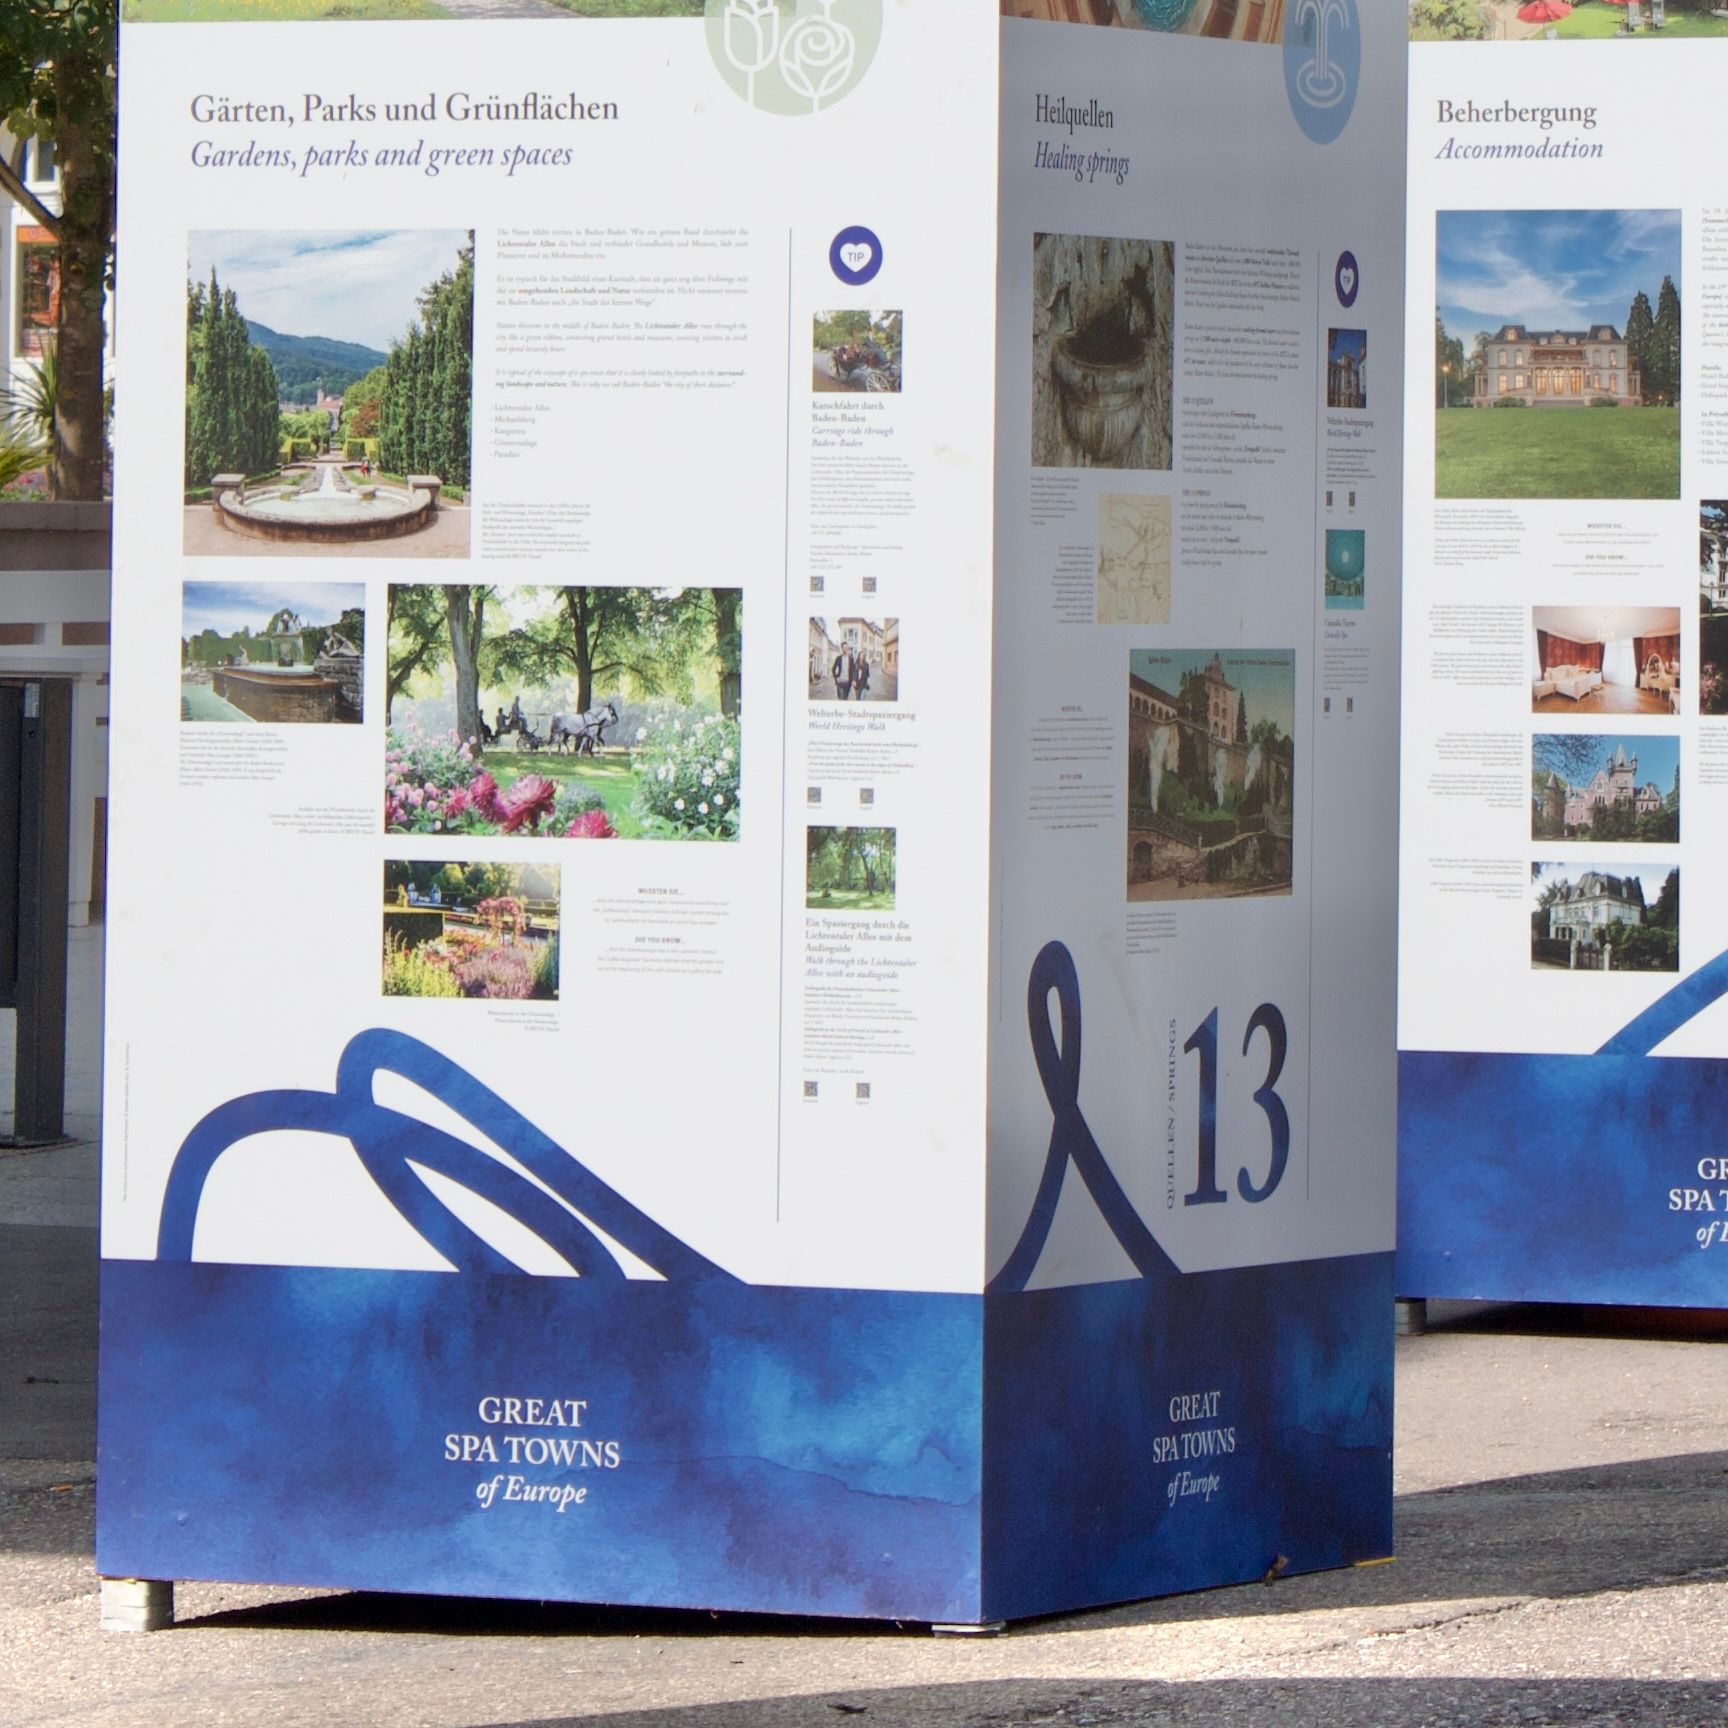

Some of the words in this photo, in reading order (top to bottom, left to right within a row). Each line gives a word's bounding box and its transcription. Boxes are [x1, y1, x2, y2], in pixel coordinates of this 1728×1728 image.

[190, 94, 295, 128] Gärten,
[303, 93, 377, 122] Parks
[385, 92, 437, 122] und
[445, 91, 619, 121] Grünflächen
[1035, 93, 1114, 136] Heilquellen
[1437, 99, 1598, 130] Beherbergung
[191, 140, 297, 171] Gardens,
[299, 139, 369, 178] parks
[374, 138, 425, 167] and
[424, 148, 494, 177] green
[500, 144, 573, 177] spaces
[1033, 140, 1086, 183] Healing
[1085, 148, 1130, 186] springs
[1434, 136, 1604, 160] Accommodation
[847, 252, 865, 262] TIP
[811, 412, 867, 423] Baden-Baden
[805, 918, 820, 928] Ein
[822, 918, 871, 930] Spaziergang
[872, 919, 895, 929] durch
[897, 920, 910, 929] die
[1168, 1019, 1176, 1102] SPRINGS
[1168, 1105, 1176, 1113] /
[1183, 1002, 1290, 1207] 13
[1167, 1117, 1176, 1210] QUELLEN
[1669, 1189, 1715, 1211] SPA
[1696, 1221, 1719, 1249] of
[478, 1396, 587, 1428] GREAT
[1169, 1391, 1221, 1423] GREAT
[445, 1434, 499, 1462] SPA
[504, 1436, 620, 1469] TOWNS
[1153, 1435, 1179, 1463] SPA
[1181, 1427, 1236, 1459] TOWNS
[476, 1475, 504, 1509] of
[503, 1476, 588, 1513] Europe
[1167, 1472, 1182, 1508] of
[1180, 1471, 1220, 1503] Europe
